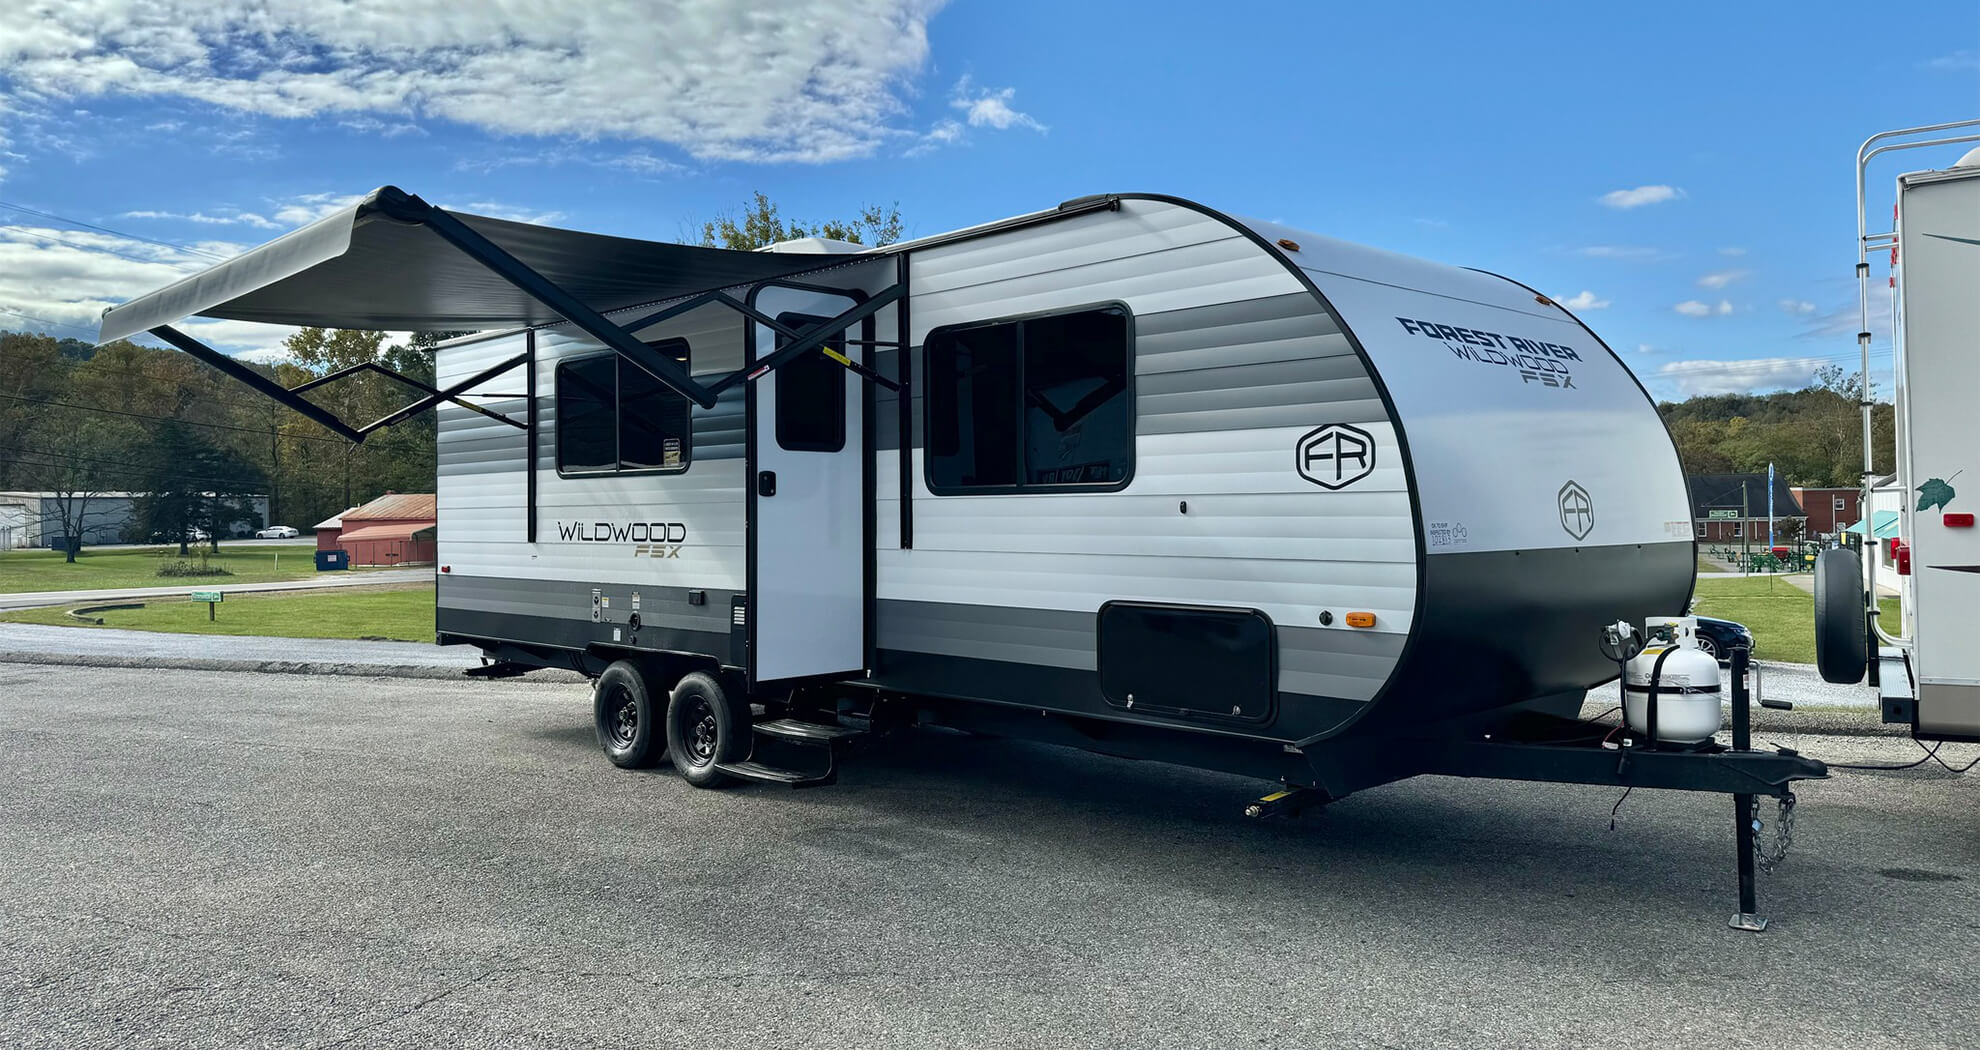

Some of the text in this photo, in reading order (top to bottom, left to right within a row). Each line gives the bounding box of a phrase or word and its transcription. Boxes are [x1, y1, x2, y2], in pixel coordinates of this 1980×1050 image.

[1395, 317, 1584, 363] FOREST RIVER
[1520, 369, 1577, 390] FSX
[634, 545, 682, 559] FSX
